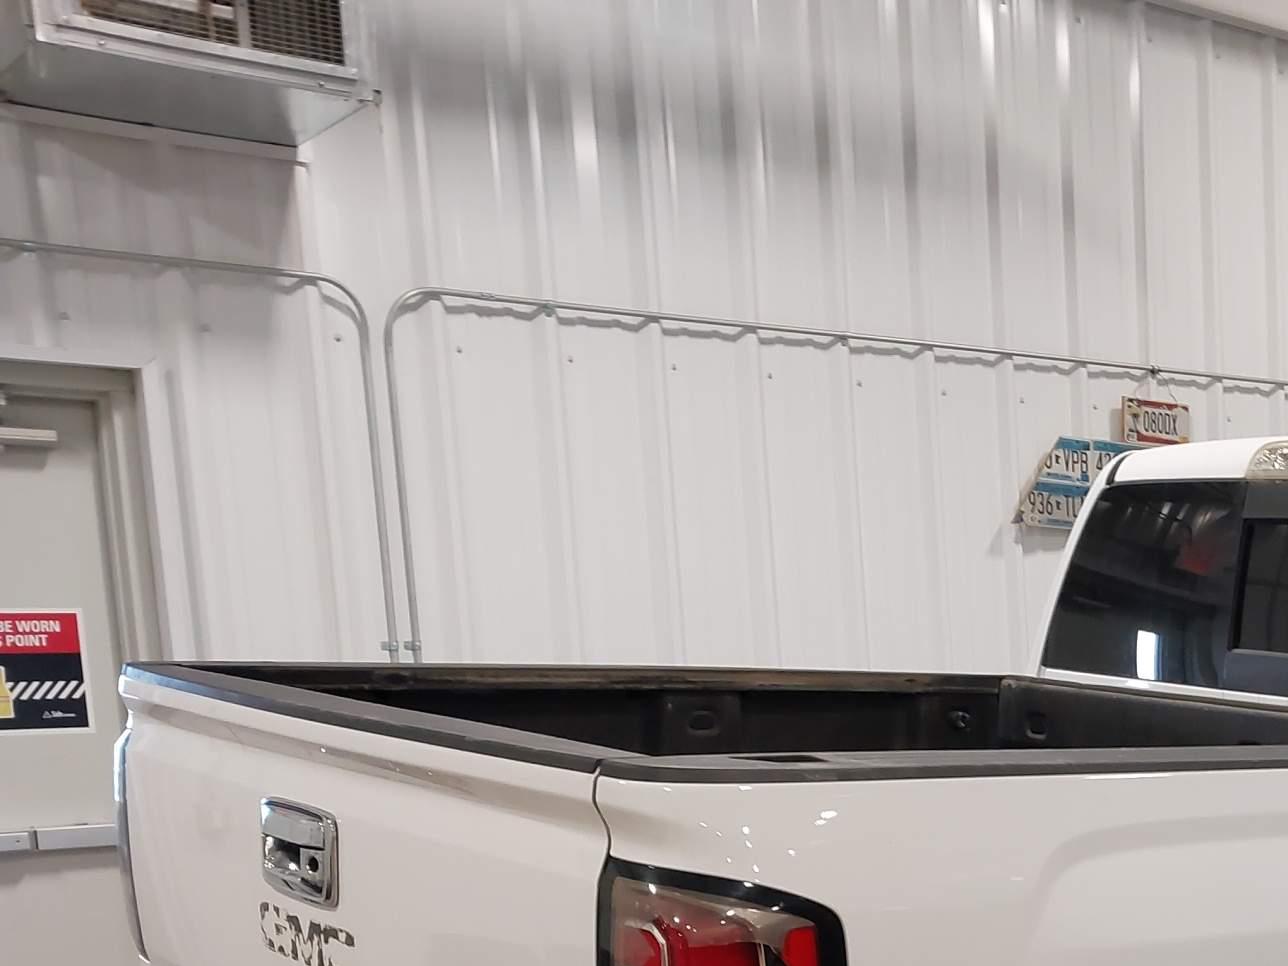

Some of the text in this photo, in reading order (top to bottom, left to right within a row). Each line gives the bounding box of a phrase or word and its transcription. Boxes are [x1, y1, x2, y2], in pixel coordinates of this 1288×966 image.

[1063, 448, 1088, 474] VPB
[1028, 492, 1053, 516] 936
[15, 620, 61, 632] WORN
[5, 634, 49, 647] POINT
